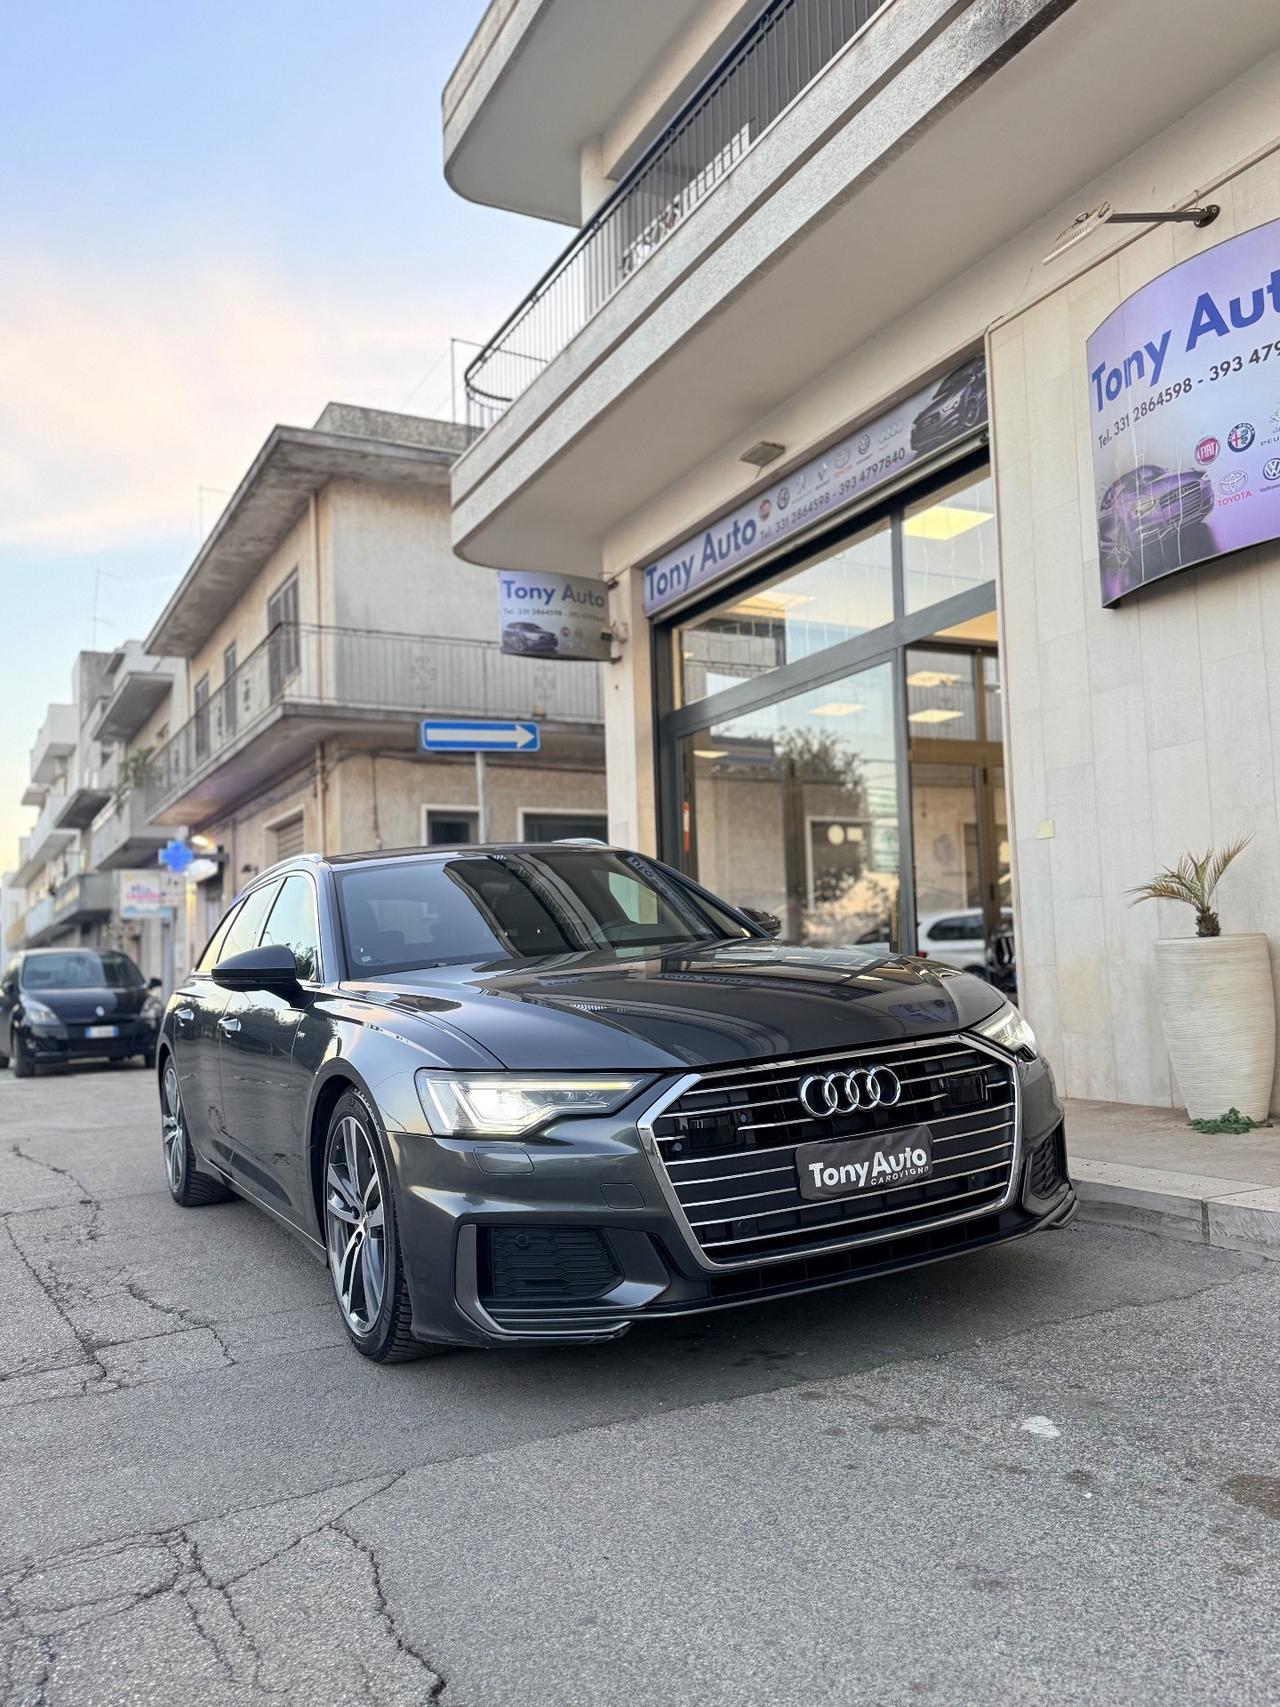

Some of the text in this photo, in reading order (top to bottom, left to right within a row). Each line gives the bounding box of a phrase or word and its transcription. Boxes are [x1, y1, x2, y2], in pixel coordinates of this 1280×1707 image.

[1092, 329, 1172, 412] Tony
[1098, 429, 1113, 449] Tel.
[1114, 413, 1130, 436] 331
[1133, 377, 1193, 423] 2864598
[1209, 355, 1243, 382] 393
[775, 516, 789, 533] 331
[791, 492, 831, 520] 2864598
[839, 476, 857, 495] 393
[860, 447, 906, 481] 4797840
[1200, 442, 1215, 459] FIAT
[1218, 490, 1252, 506] TOYOTA
[502, 580, 605, 608] Tony Auto
[646, 519, 756, 600] Tony Auto
